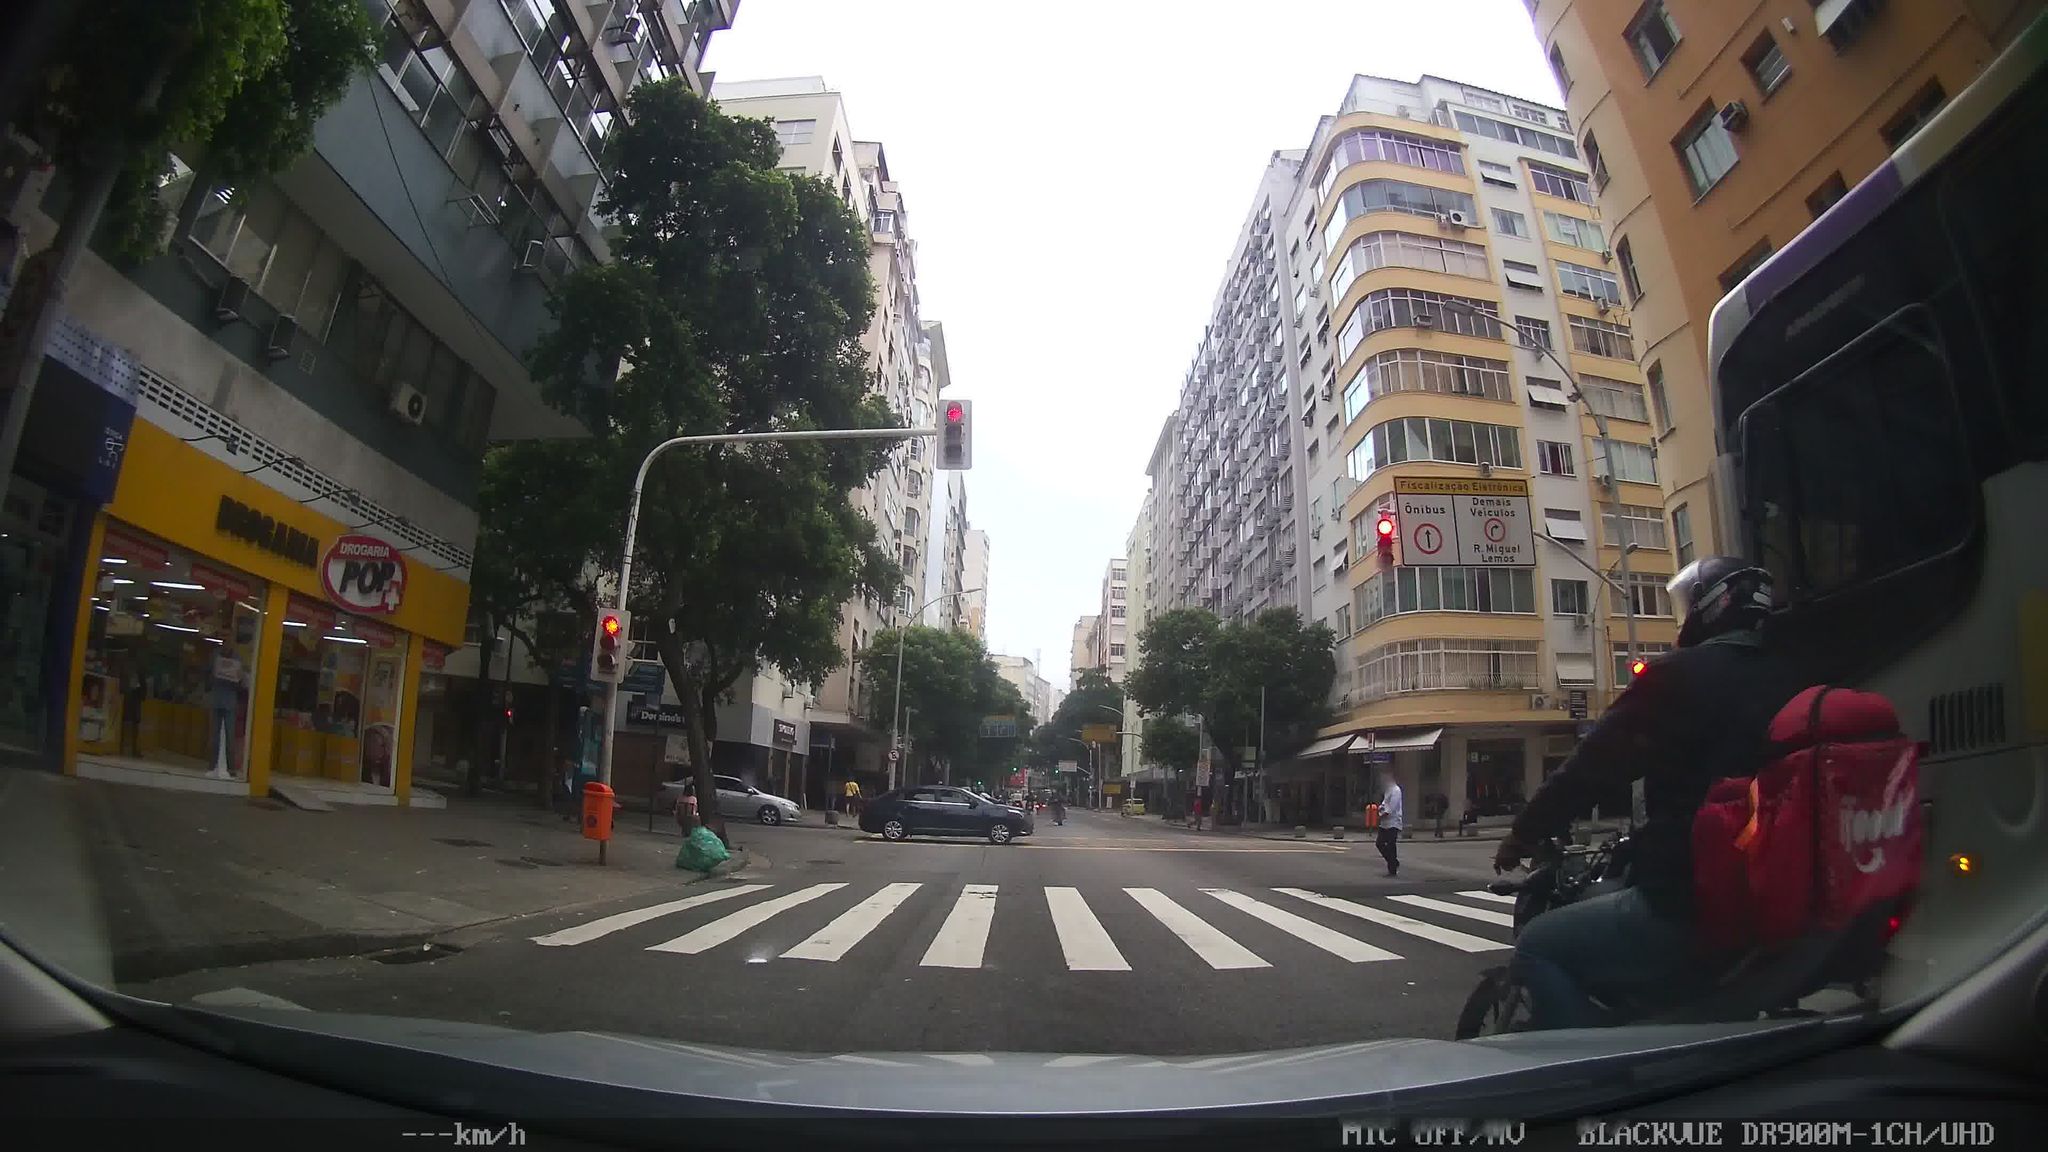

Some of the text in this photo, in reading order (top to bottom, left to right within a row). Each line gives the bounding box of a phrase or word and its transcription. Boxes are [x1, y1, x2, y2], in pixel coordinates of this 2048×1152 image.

[1400, 480, 1524, 493] Fiscalização Eletrônica
[1405, 502, 1446, 514] Ônibus
[1472, 497, 1512, 507] Demais
[339, 541, 391, 558] DROGARIA
[1486, 544, 1521, 556] Miguel
[1481, 554, 1516, 563] Lemos
[339, 559, 396, 595] POP
